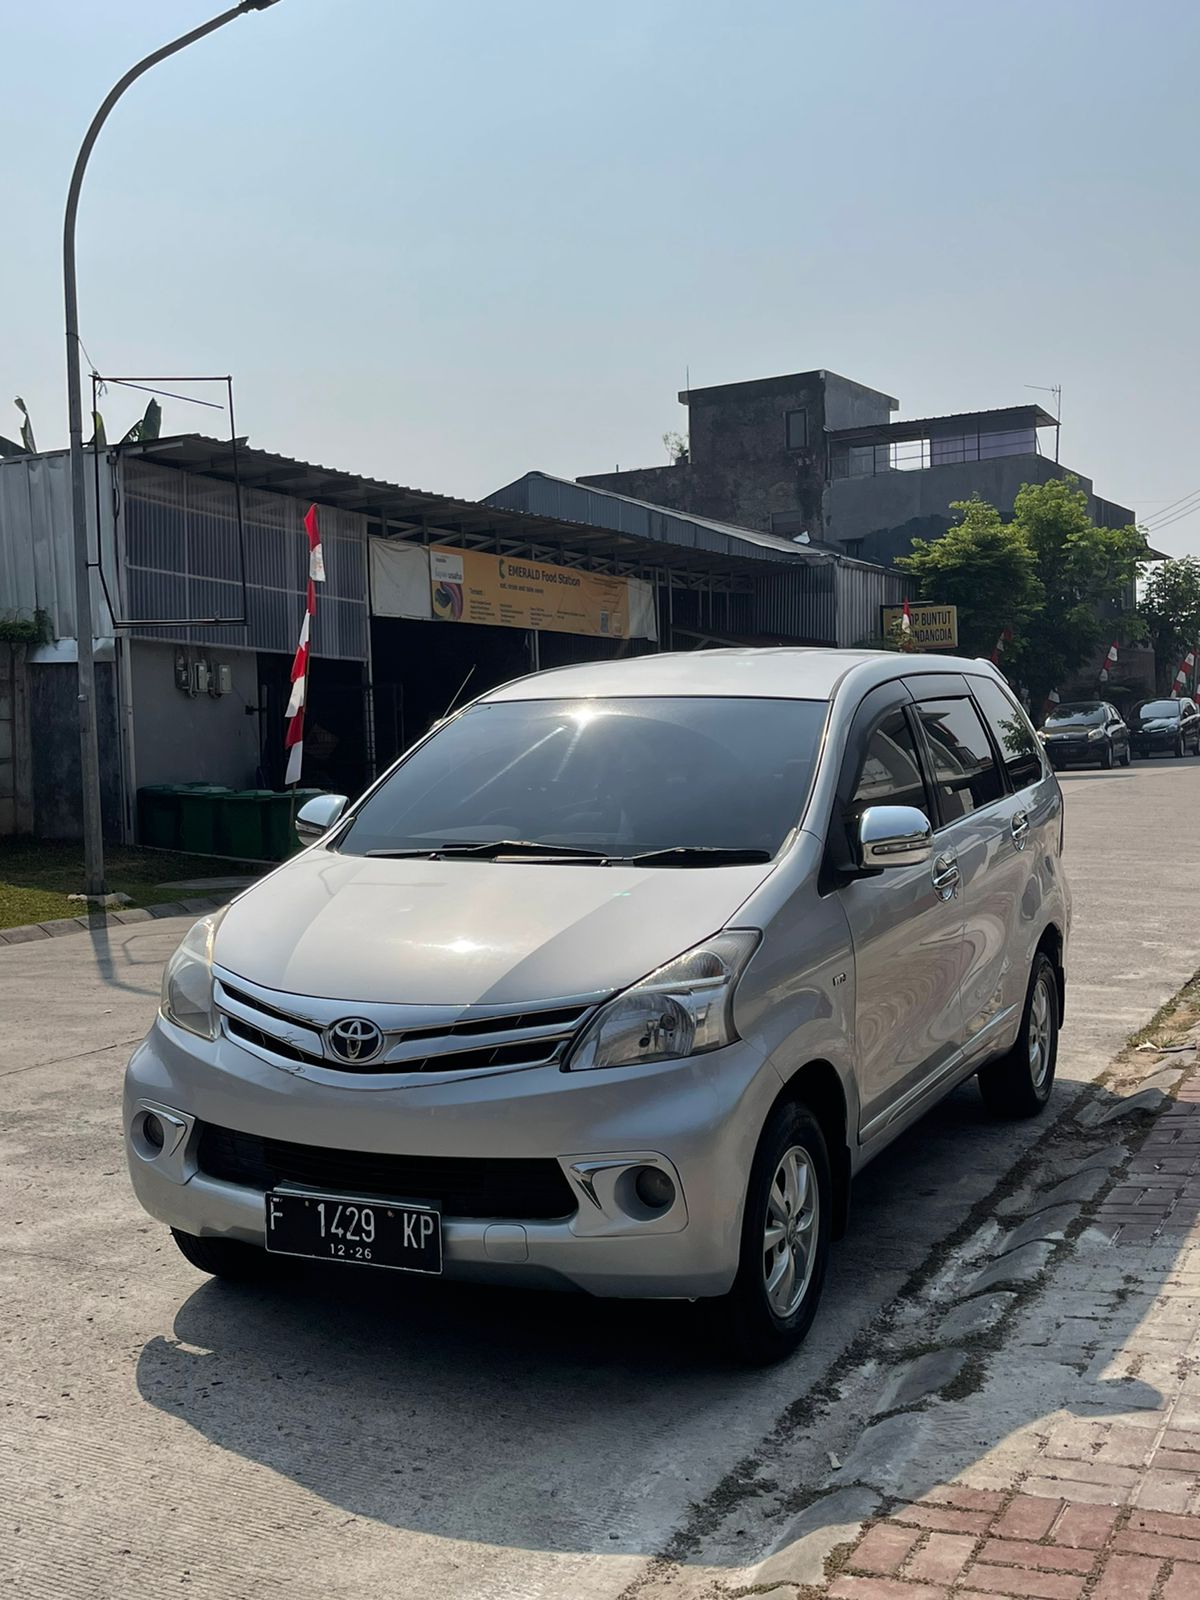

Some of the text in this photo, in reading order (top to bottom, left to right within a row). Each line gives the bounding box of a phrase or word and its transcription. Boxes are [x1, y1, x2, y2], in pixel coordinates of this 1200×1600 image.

[508, 564, 581, 586] EMERALD Food Station
[921, 611, 952, 626] BUNTUT
[270, 1197, 434, 1249] F 1429 KP
